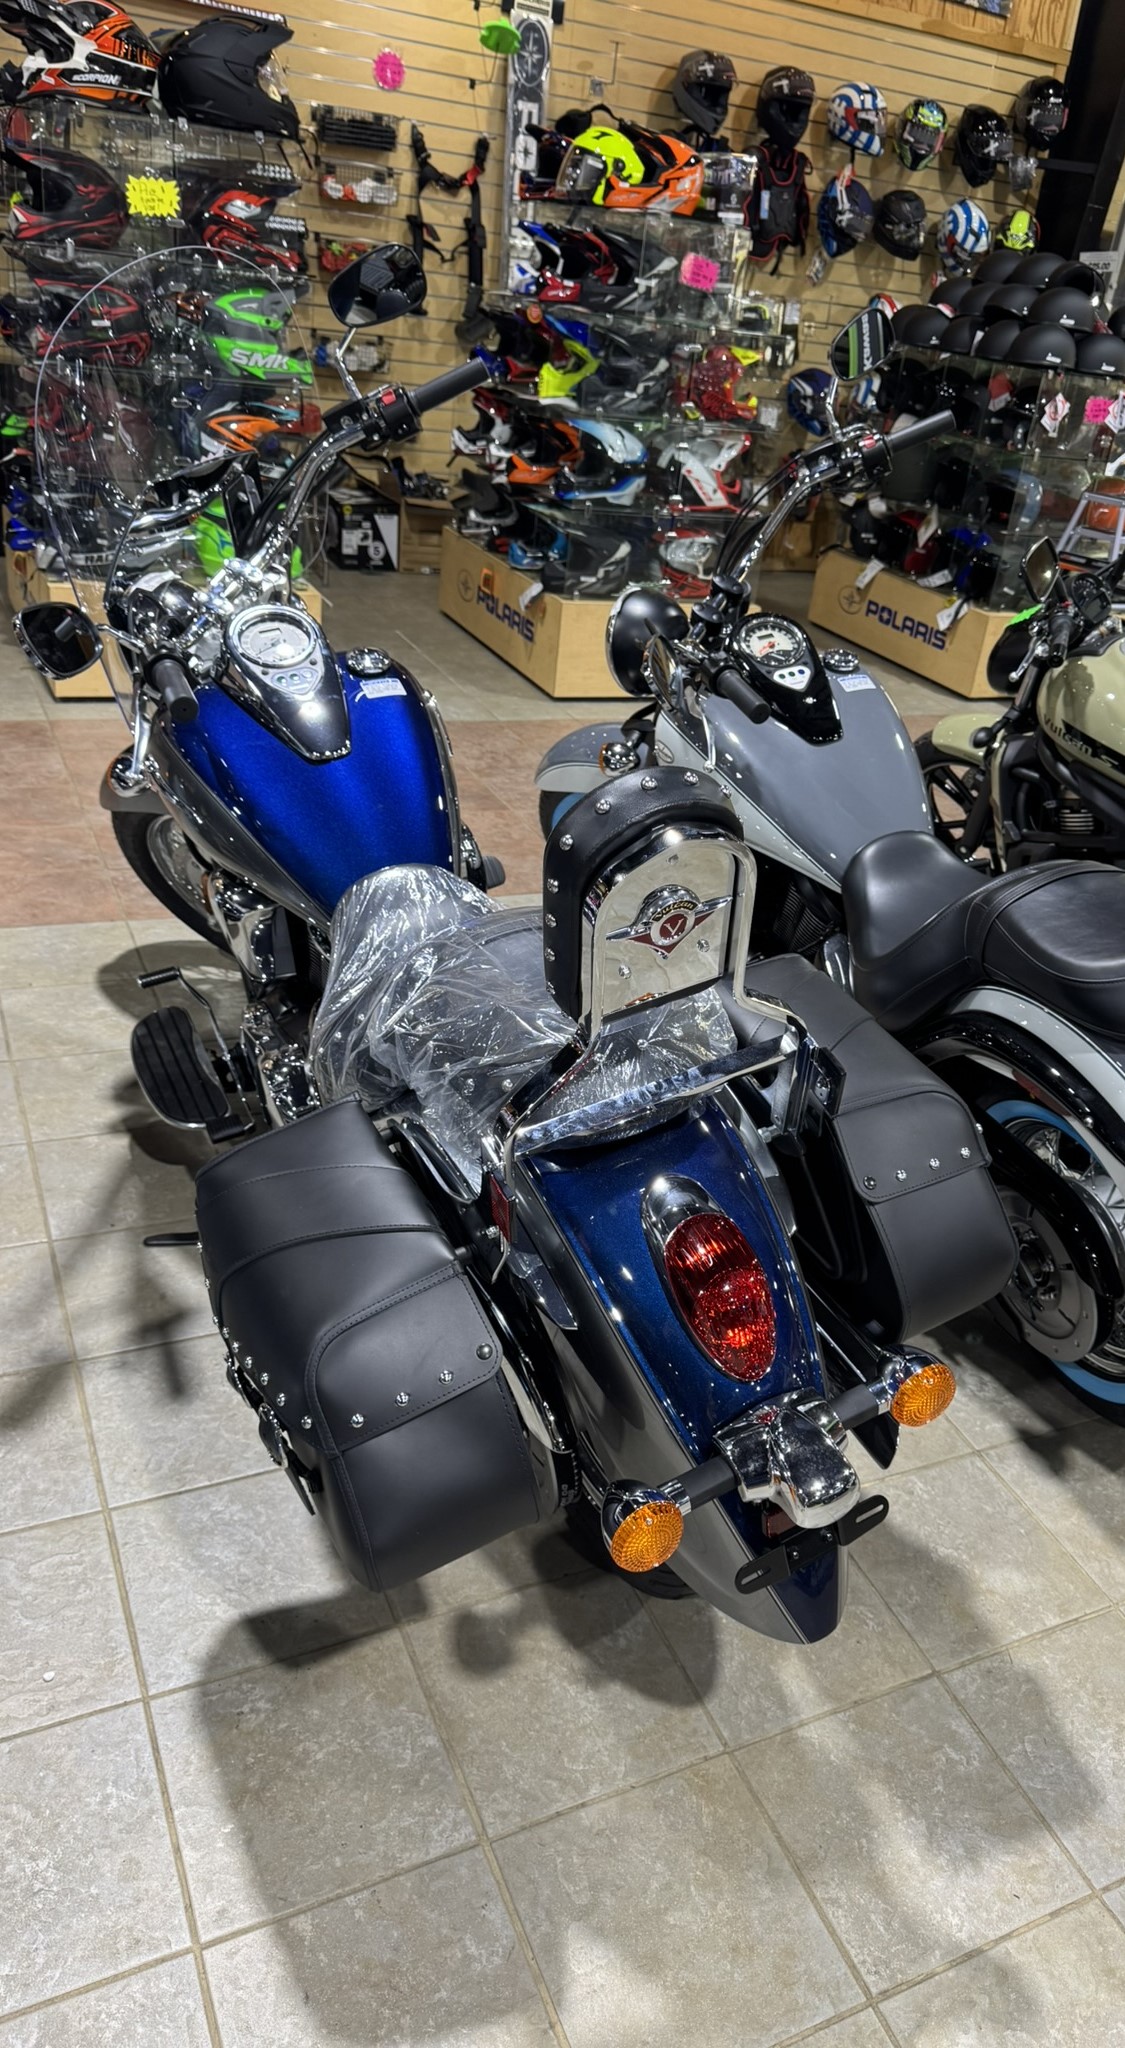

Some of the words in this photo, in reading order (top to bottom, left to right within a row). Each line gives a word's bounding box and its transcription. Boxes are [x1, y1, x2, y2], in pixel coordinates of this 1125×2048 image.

[231, 348, 289, 370] SMK
[865, 599, 948, 651] POLARIS
[1043, 714, 1093, 757] Vulcan
[654, 901, 694, 919] Vulcan
[663, 918, 685, 936] V
